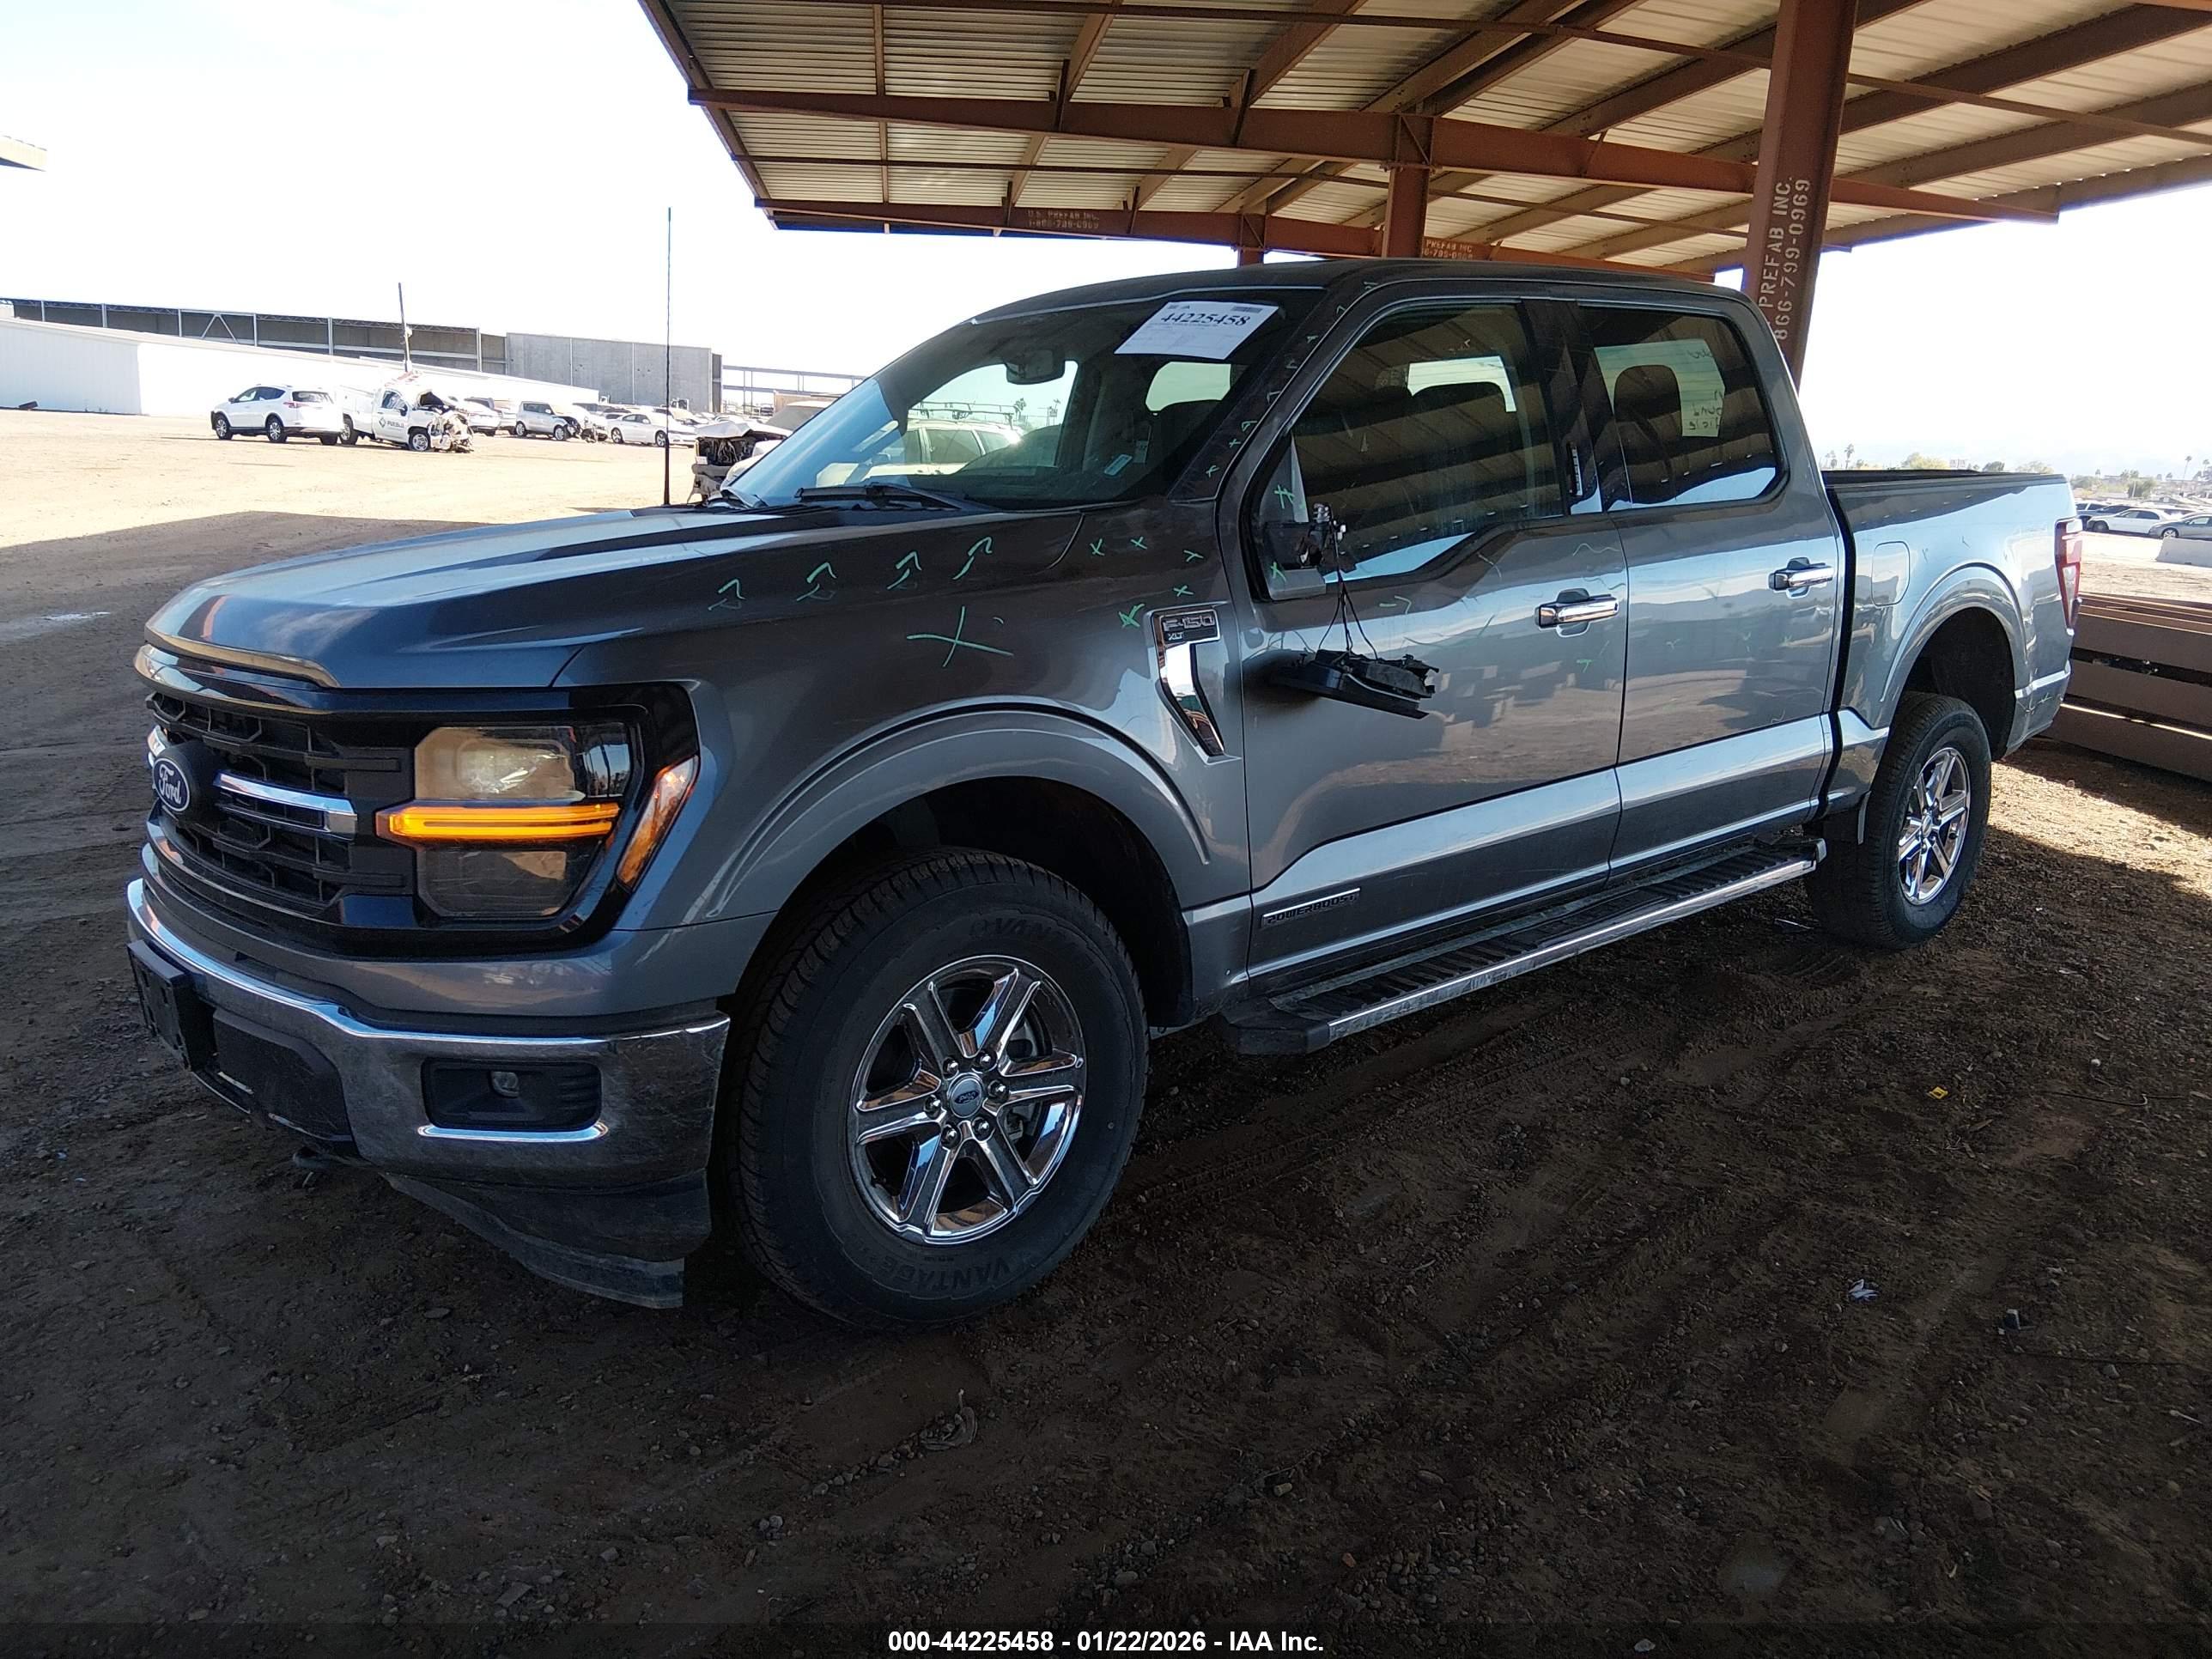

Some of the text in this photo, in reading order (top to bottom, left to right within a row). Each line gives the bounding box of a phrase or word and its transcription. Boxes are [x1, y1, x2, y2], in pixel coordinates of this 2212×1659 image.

[1048, 210, 1081, 220] PREFAB
[1425, 240, 1457, 251] PREFAB
[1758, 176, 1793, 308] PREFAB INC.
[1160, 313, 1251, 326] 44225458
[1162, 614, 1216, 632] F-150
[1168, 631, 1184, 641] XLT
[157, 763, 184, 805] Ford
